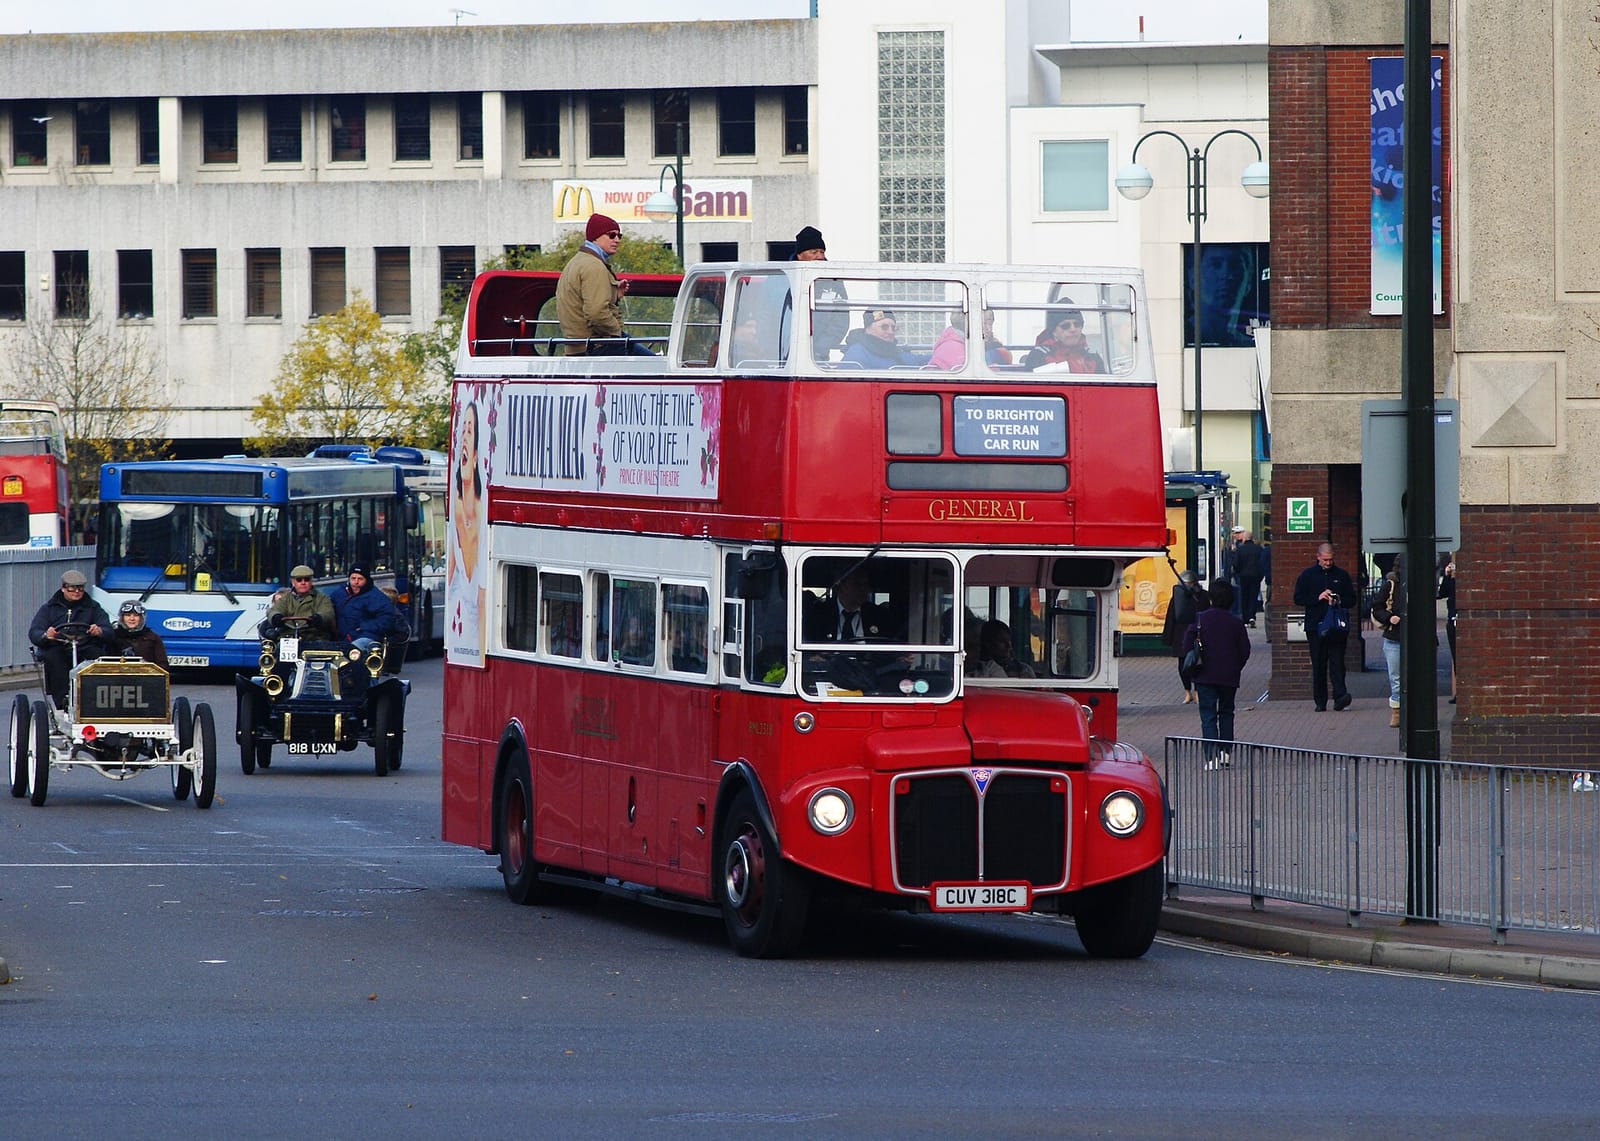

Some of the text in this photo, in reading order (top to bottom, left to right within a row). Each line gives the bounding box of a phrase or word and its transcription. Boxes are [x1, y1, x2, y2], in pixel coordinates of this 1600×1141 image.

[605, 191, 632, 203] NOW
[673, 183, 748, 217] 6am
[610, 393, 695, 427] HAVING THE TIME
[965, 409, 1054, 421] TO BRIGHTON
[982, 424, 1039, 435] VETERAN
[613, 431, 626, 463] OF
[628, 431, 655, 464] YOUR
[984, 439, 1040, 451] CAR RUN
[620, 468, 680, 486] PRINCE OF WALES THEATRE
[929, 499, 1034, 522] GENERAL
[165, 620, 212, 629] METROBUS
[281, 652, 297, 661] 319
[96, 685, 149, 708] OPEL
[289, 743, 336, 753] 818 UXN
[946, 888, 1016, 904] CUV 318C
